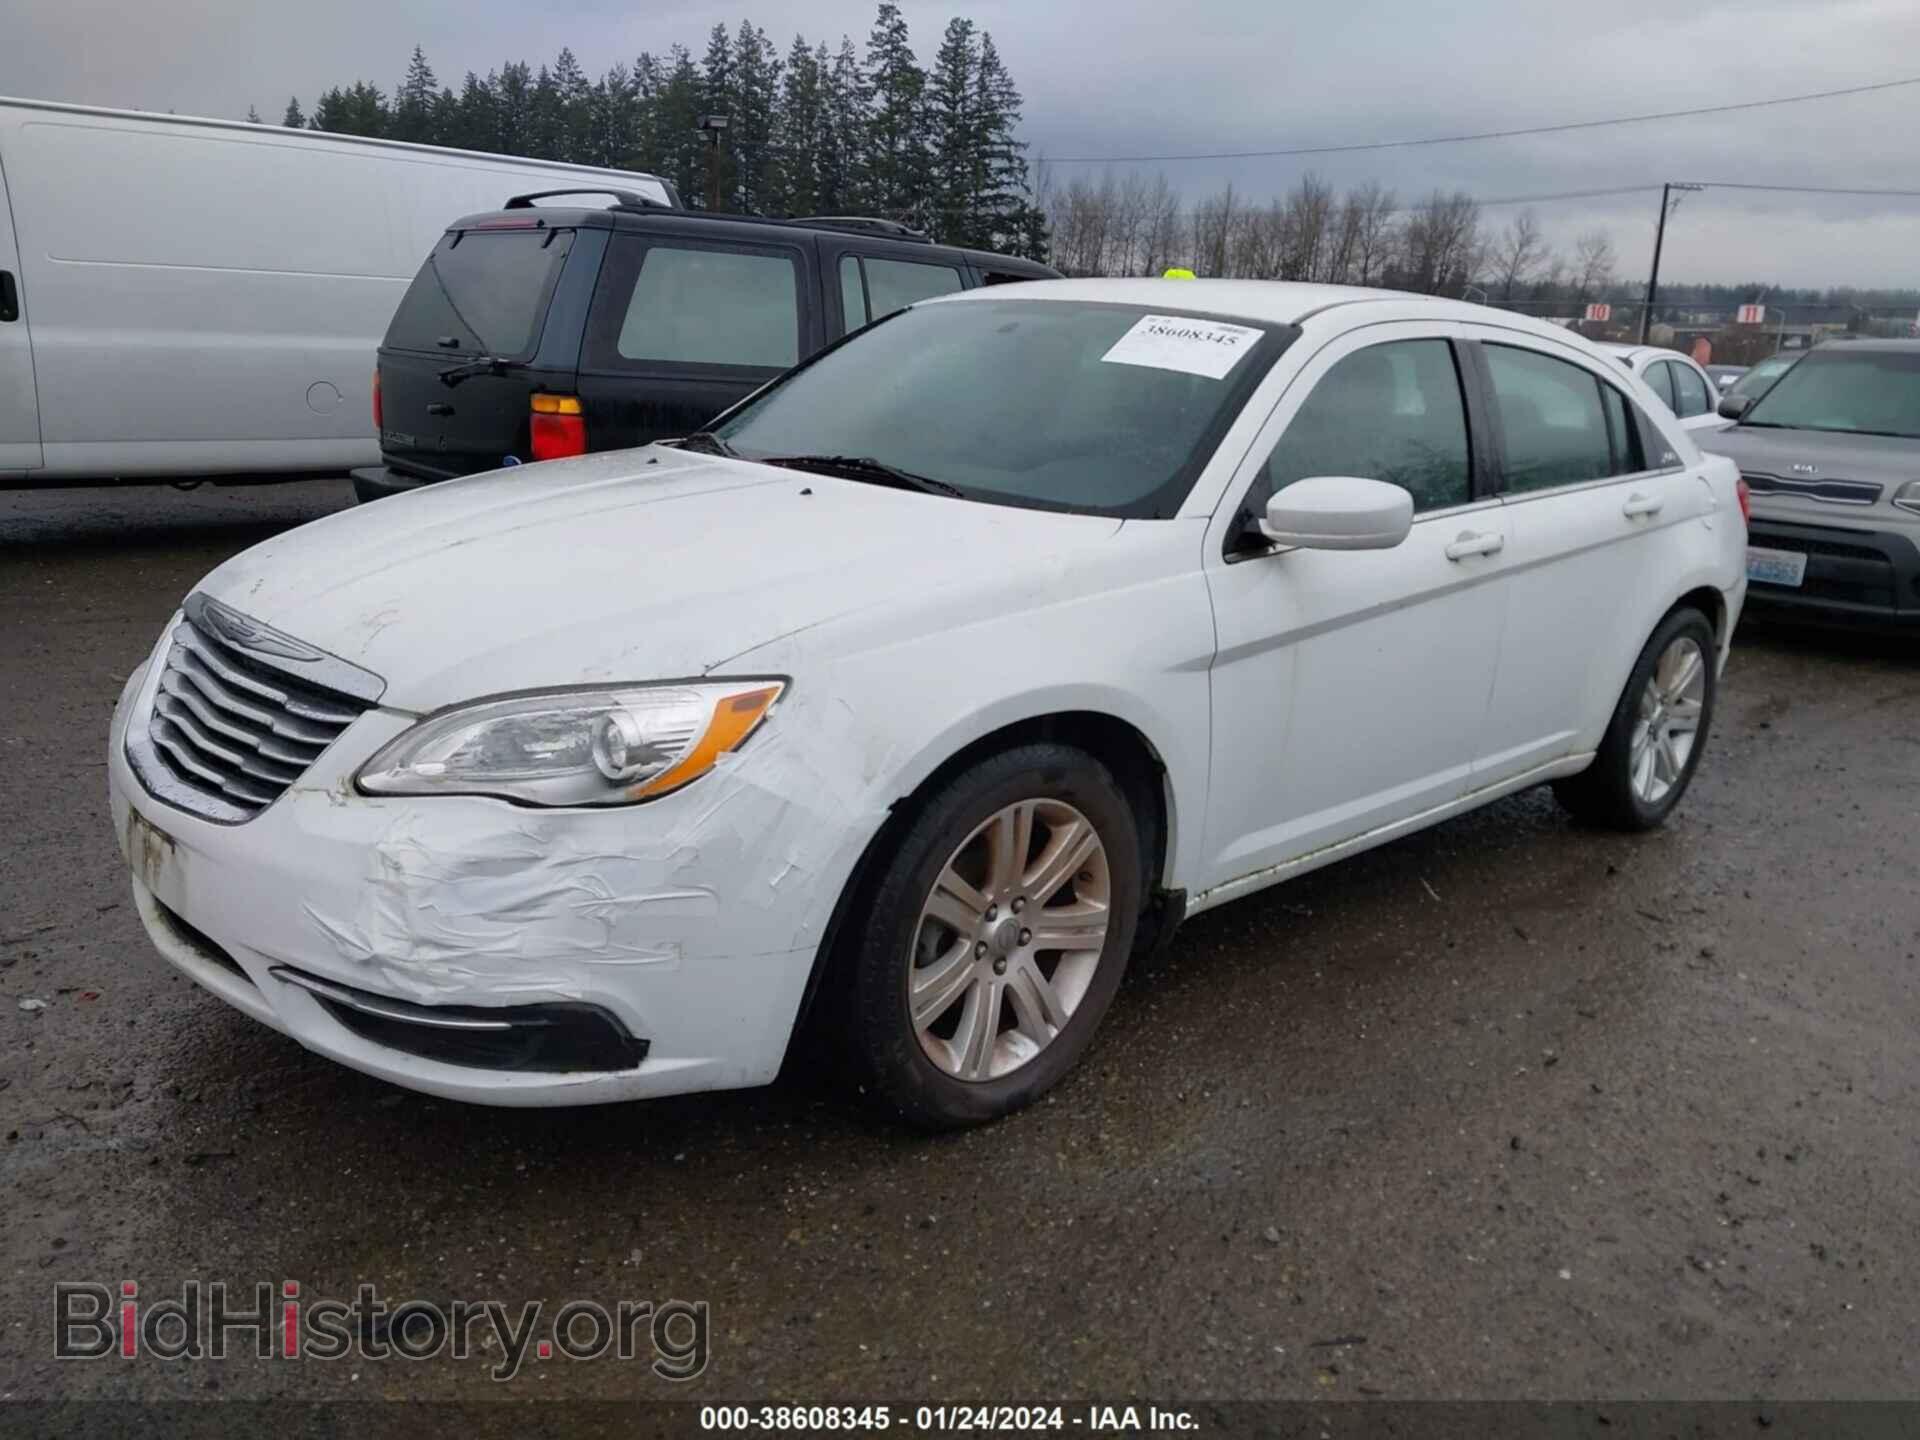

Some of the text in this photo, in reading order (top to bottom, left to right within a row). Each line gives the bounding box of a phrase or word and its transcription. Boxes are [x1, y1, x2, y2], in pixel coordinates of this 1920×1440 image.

[1591, 304, 1606, 320] 10
[1744, 305, 1758, 322] 11
[1141, 323, 1240, 346] 38608345
